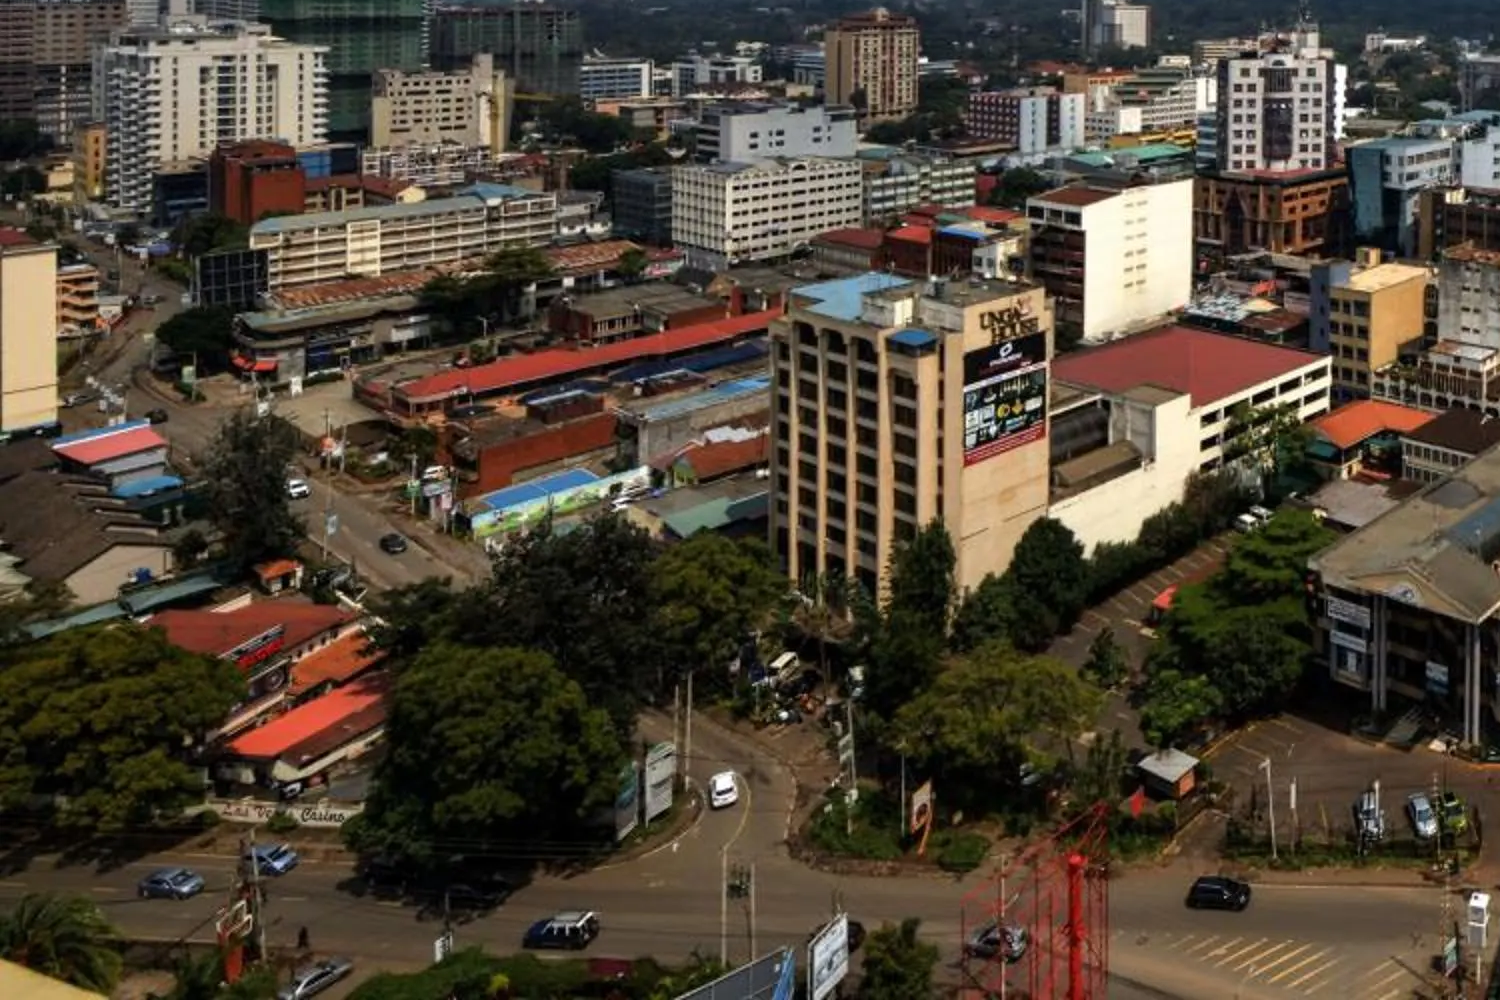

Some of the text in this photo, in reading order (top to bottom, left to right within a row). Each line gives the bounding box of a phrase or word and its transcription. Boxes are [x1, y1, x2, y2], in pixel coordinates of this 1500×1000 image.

[980, 307, 1020, 330] UNGA
[991, 317, 1038, 345] HOUSE
[222, 803, 249, 816] Las
[301, 807, 346, 823] Casino
